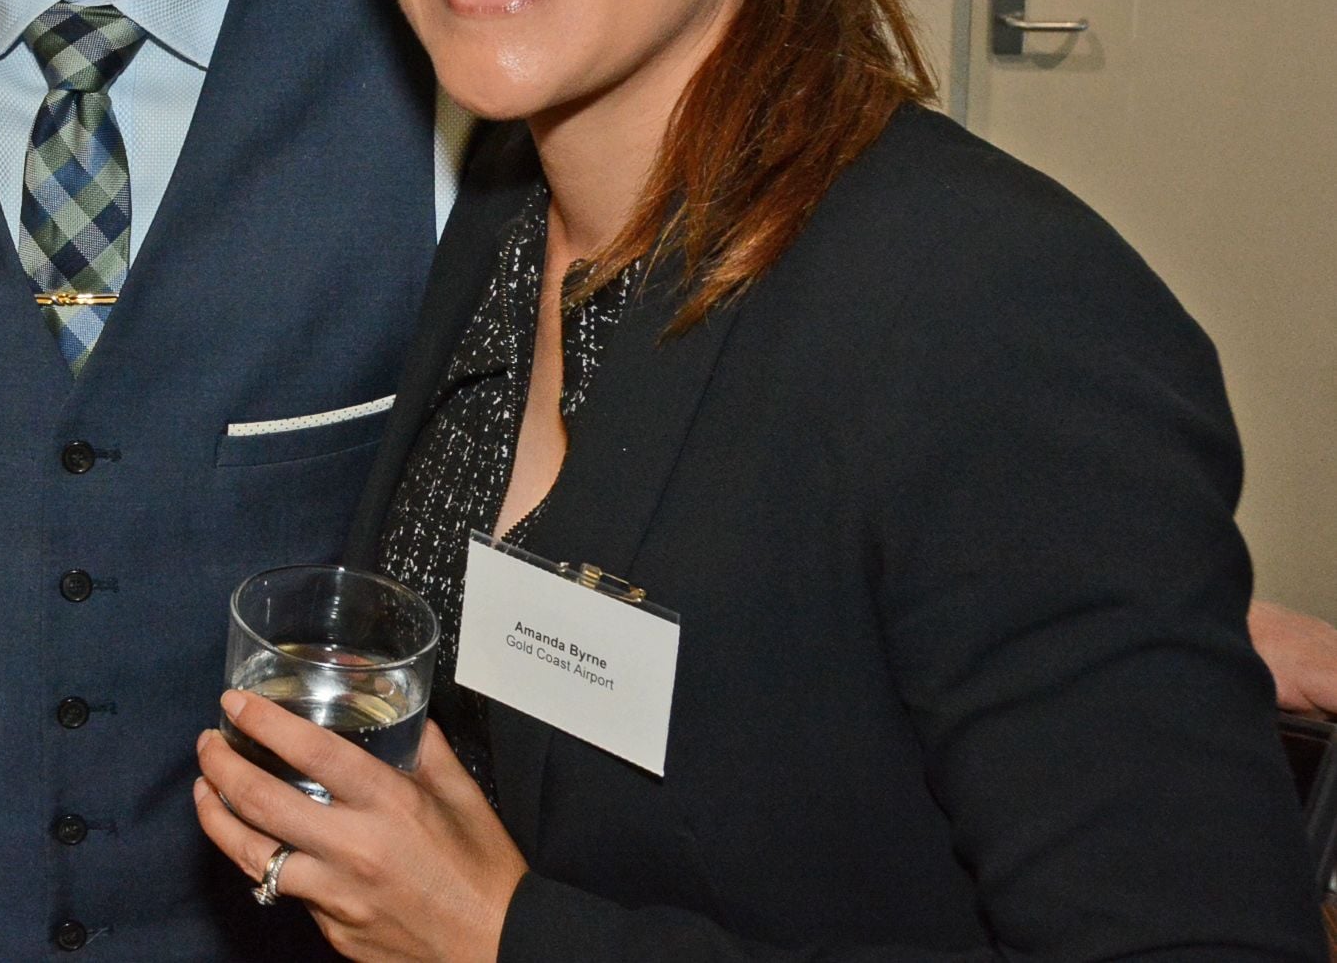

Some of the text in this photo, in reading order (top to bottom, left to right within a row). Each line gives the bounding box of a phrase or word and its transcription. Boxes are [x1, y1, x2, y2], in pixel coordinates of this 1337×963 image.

[505, 635, 615, 691] Gold Coast Airport
[514, 621, 608, 670] Amanda Byrne
